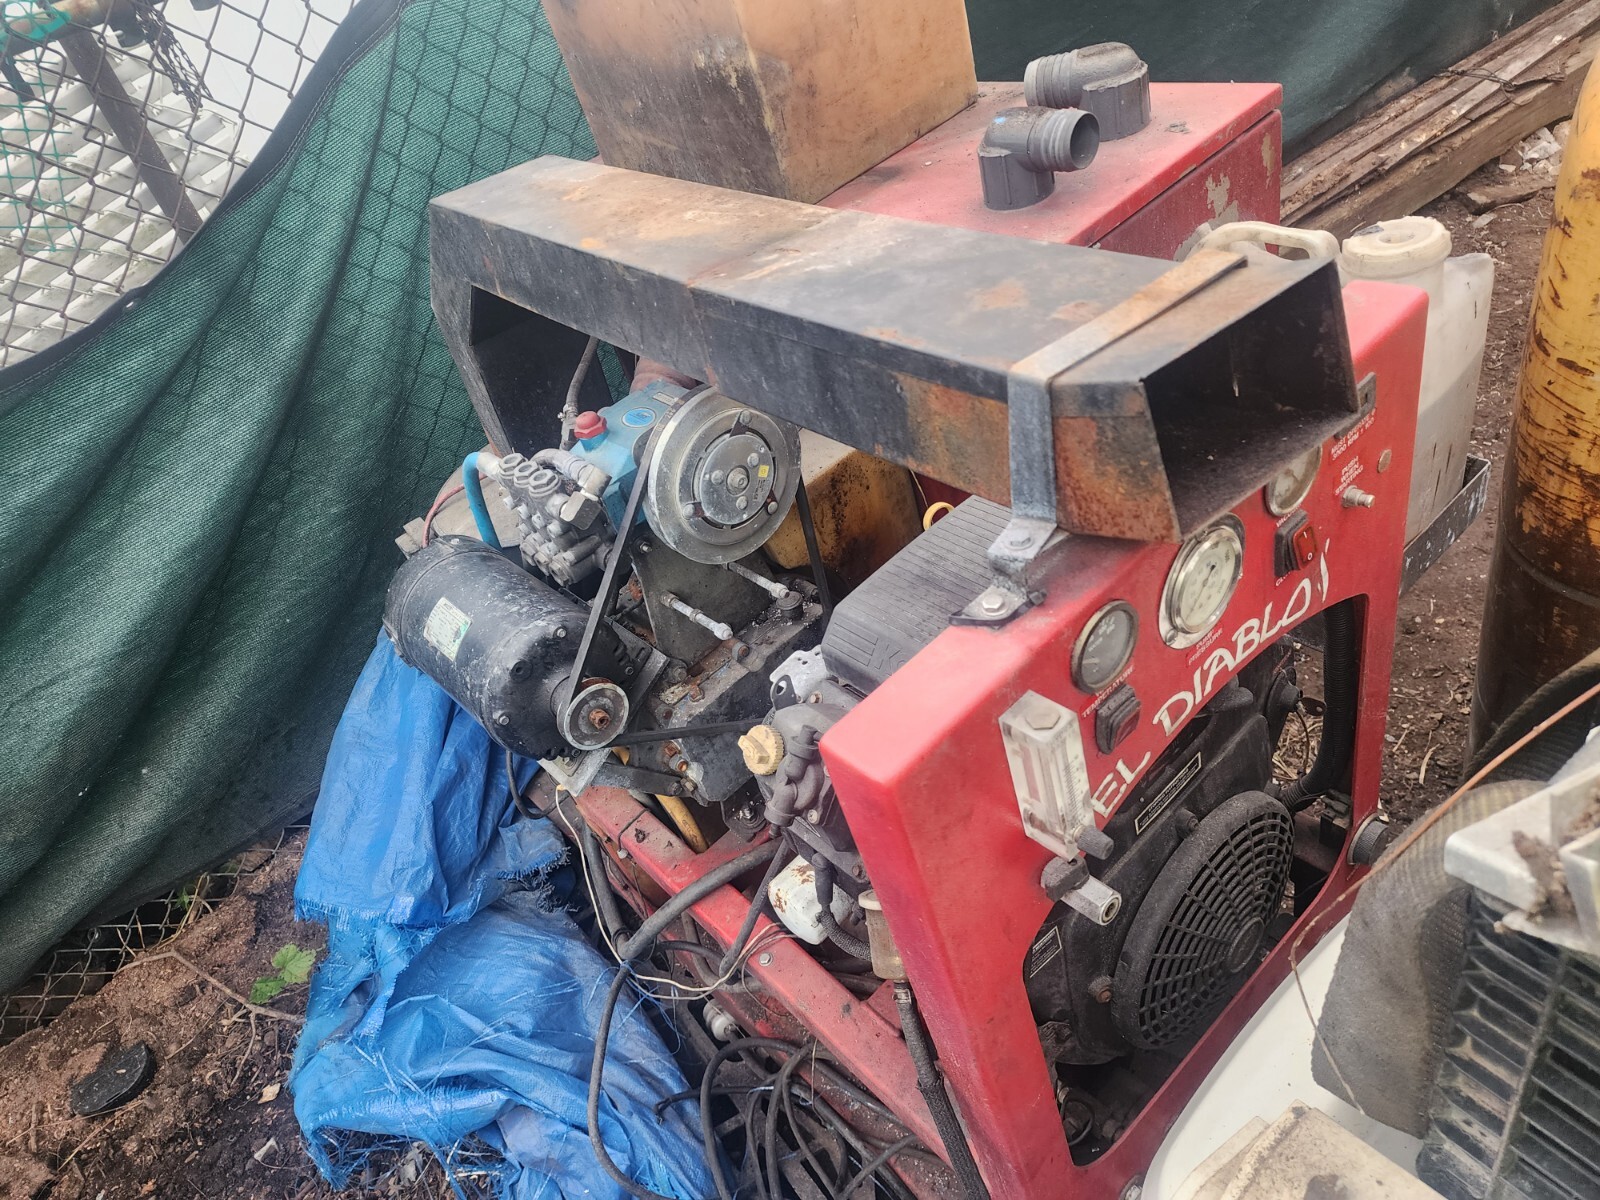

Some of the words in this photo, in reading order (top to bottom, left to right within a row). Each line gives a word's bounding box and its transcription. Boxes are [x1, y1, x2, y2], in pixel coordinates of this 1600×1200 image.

[1331, 435, 1347, 454] MUST
[1335, 464, 1364, 496] STARTING
[1340, 462, 1359, 483] WHEN
[1341, 455, 1359, 475] PUSH
[1188, 627, 1223, 666] PRESSURE
[1082, 664, 1135, 718] TEMPERATURE
[1091, 751, 1151, 819] EL
[1152, 577, 1311, 737] DIABLO
